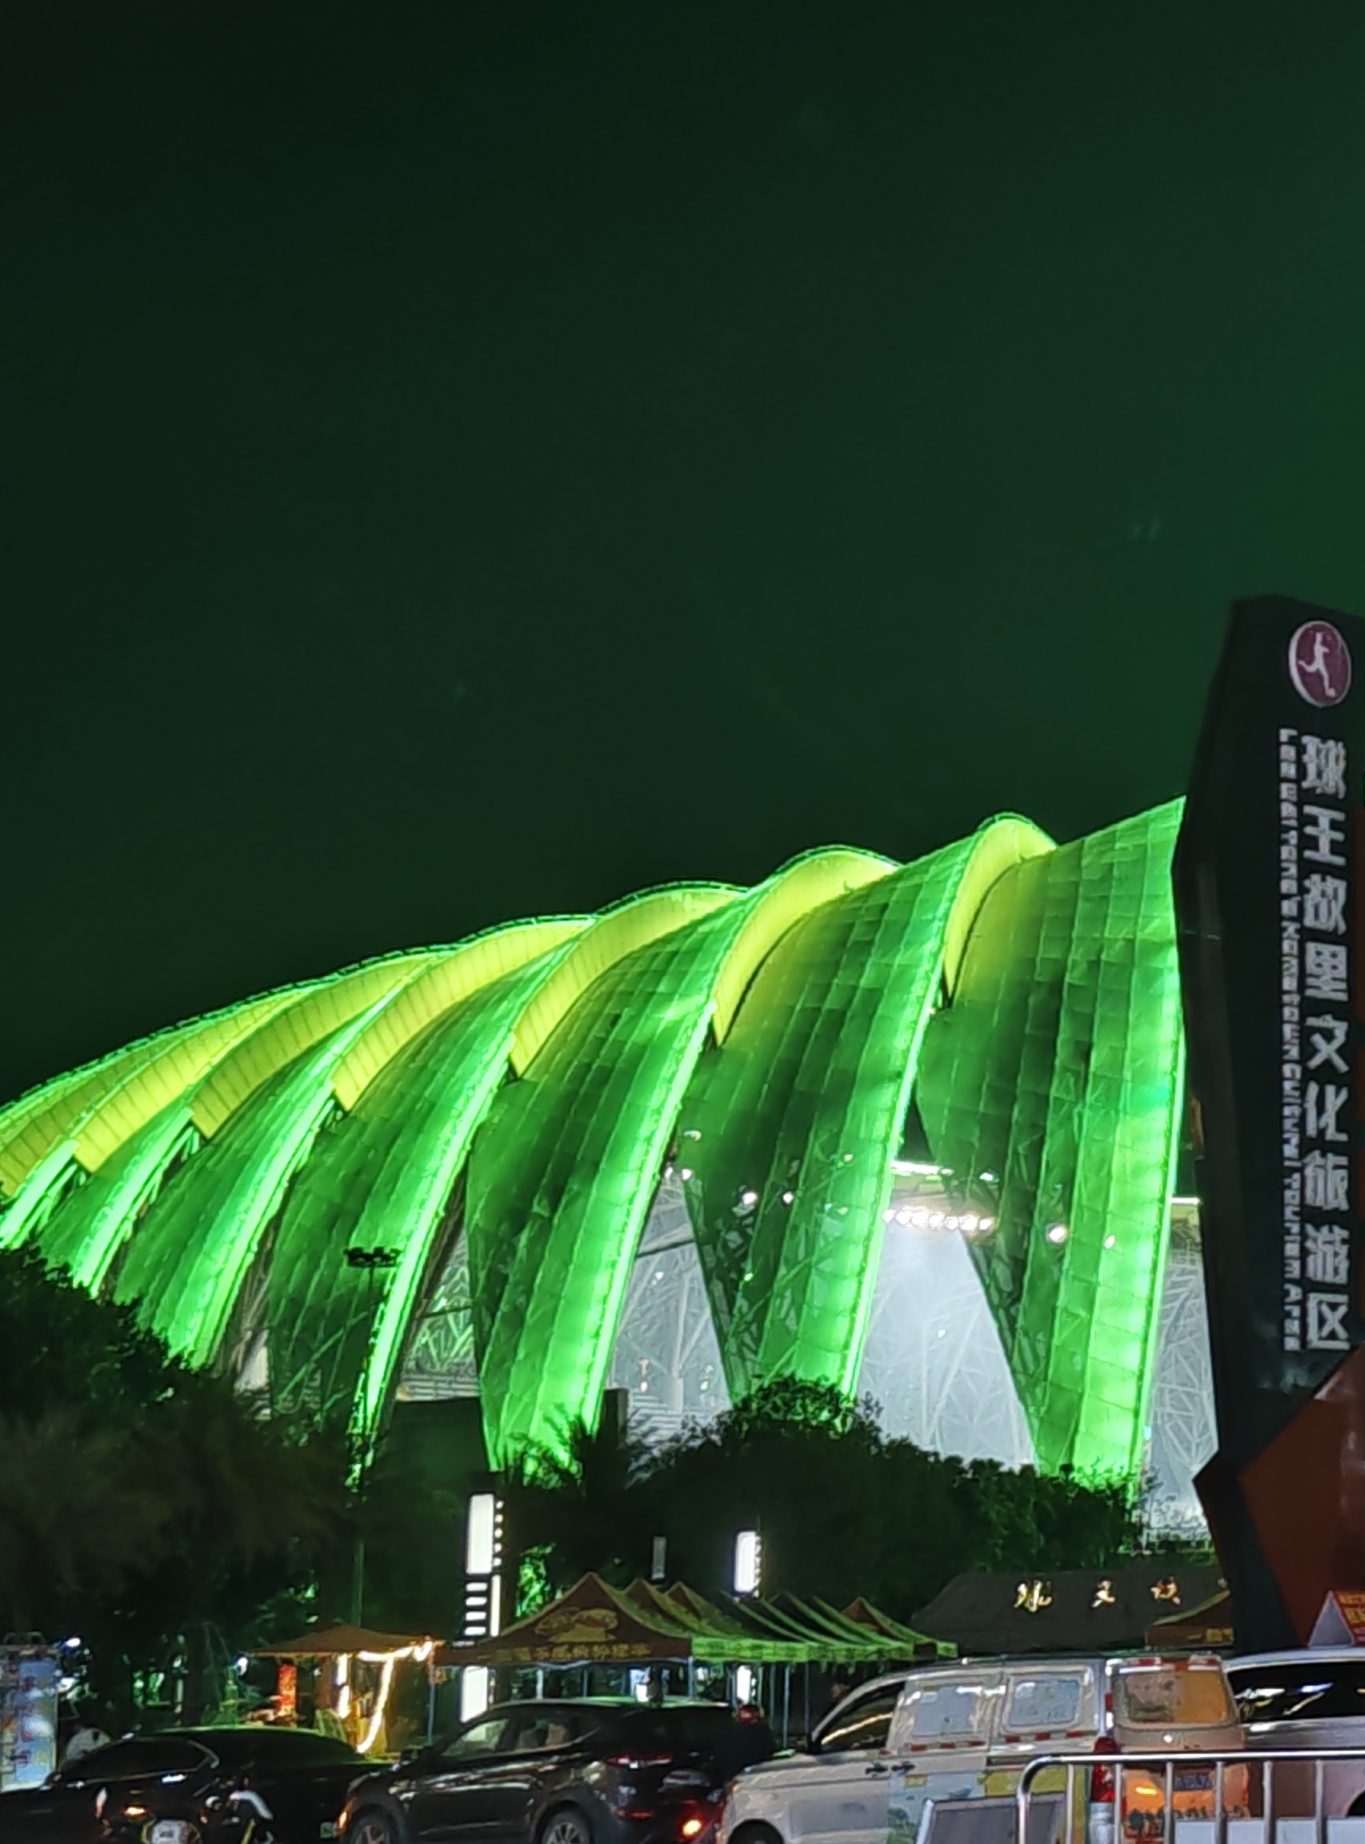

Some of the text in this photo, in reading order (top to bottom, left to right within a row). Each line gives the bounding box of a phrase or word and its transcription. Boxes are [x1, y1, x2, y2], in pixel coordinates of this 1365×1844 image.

[1301, 734, 1351, 1352] 球王故里文化旅游区
